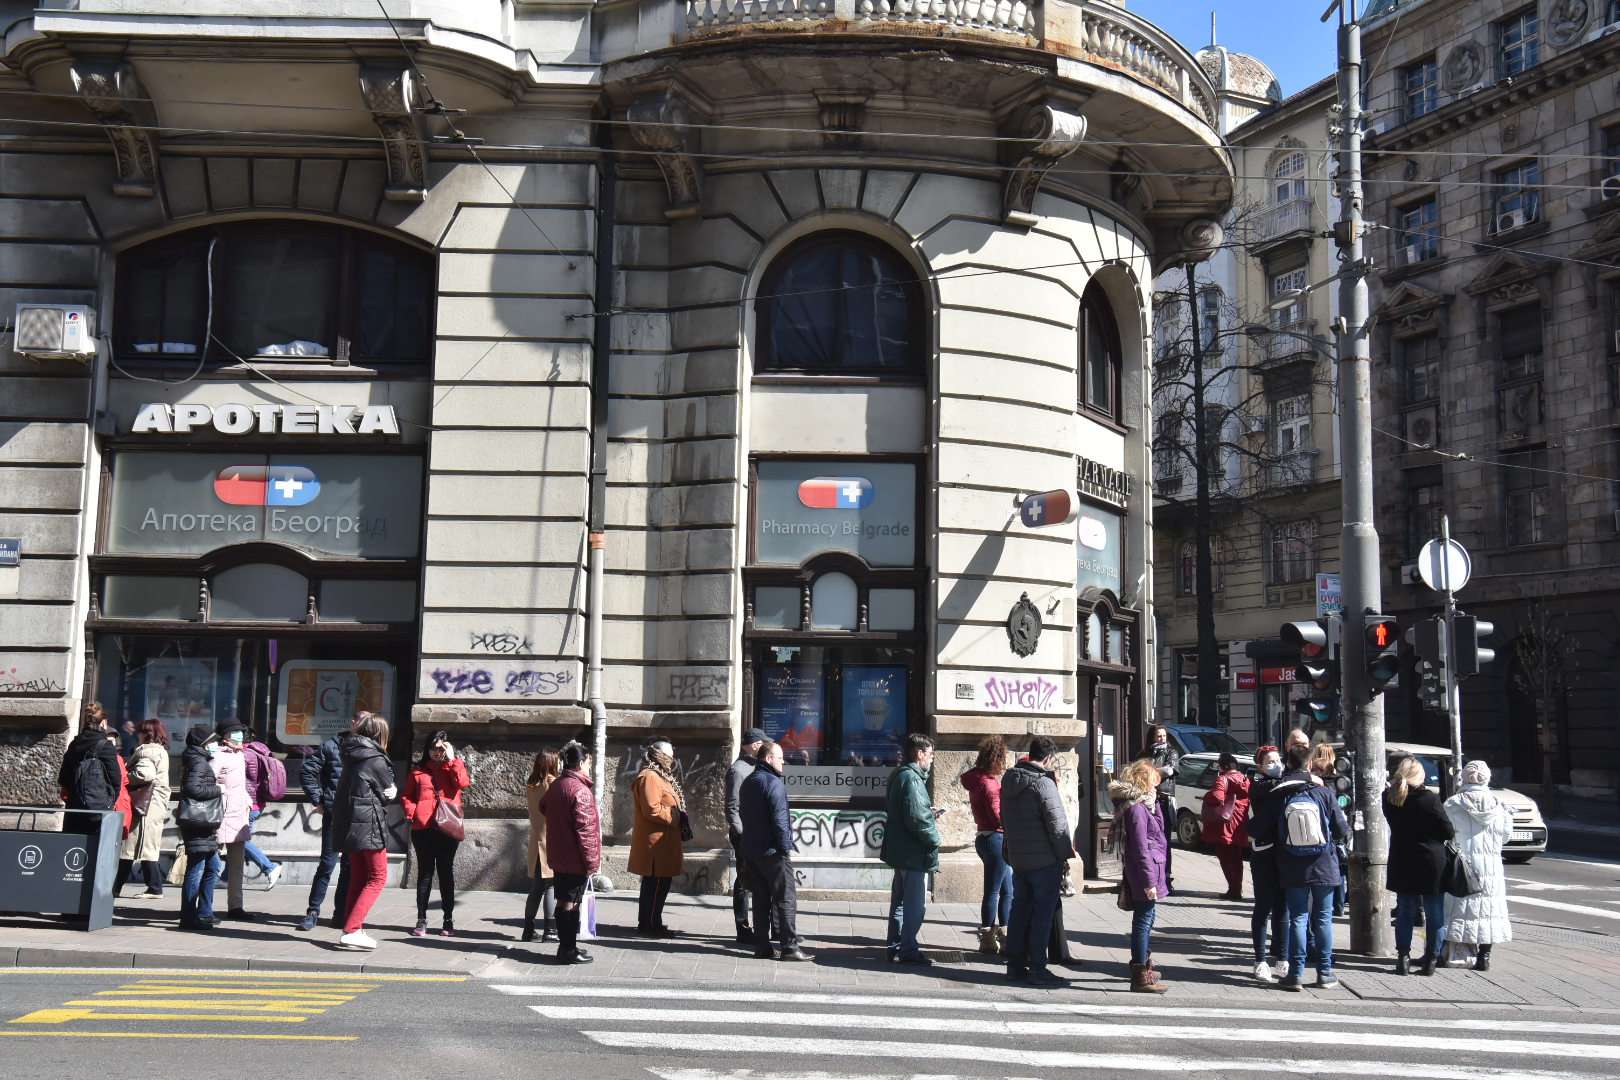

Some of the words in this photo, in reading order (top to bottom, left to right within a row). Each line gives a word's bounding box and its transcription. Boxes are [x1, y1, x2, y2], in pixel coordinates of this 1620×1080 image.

[132, 402, 401, 435] APOTEKA
[1076, 455, 1132, 496] HARMACIE
[141, 508, 256, 532] Апотека
[271, 509, 386, 538] Београд
[762, 520, 837, 539] Pharmacy
[843, 520, 910, 537] Belgrade
